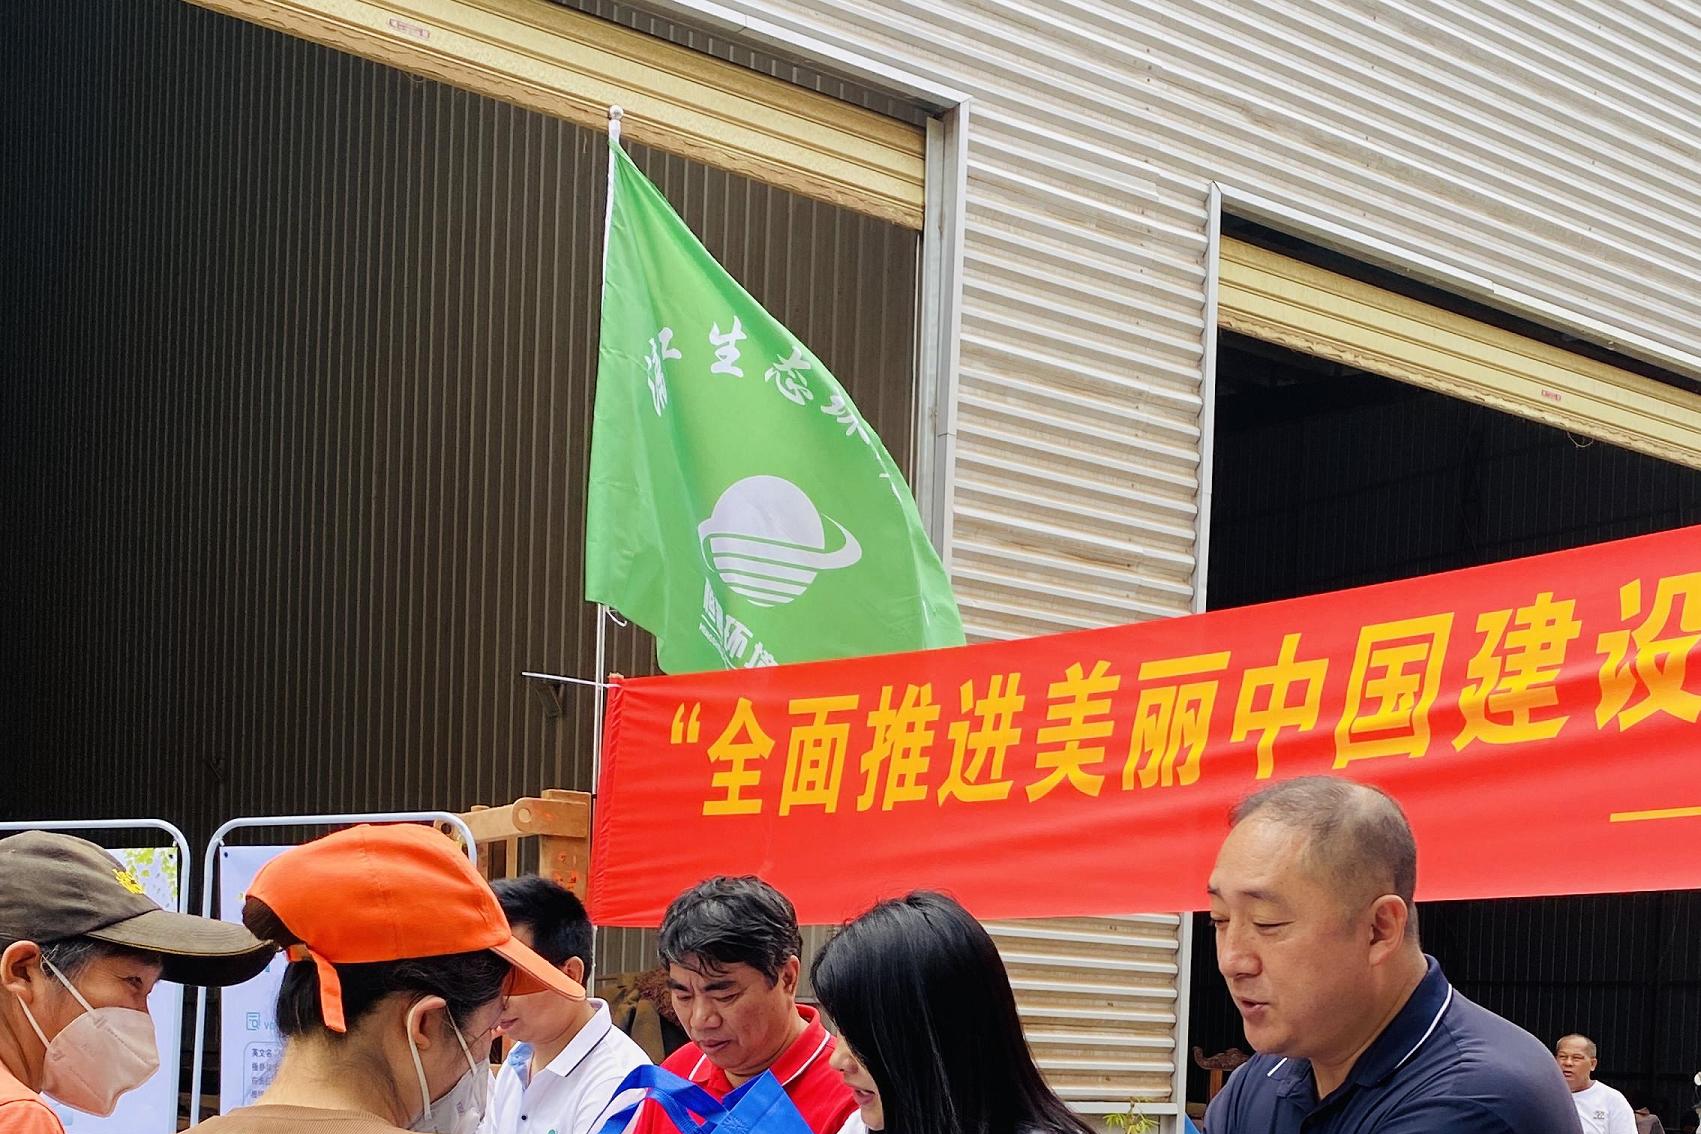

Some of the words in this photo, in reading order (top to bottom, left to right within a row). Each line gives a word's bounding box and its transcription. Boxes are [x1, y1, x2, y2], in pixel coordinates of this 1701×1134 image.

[668, 571, 1701, 817] “全面推进美丽中国建设
